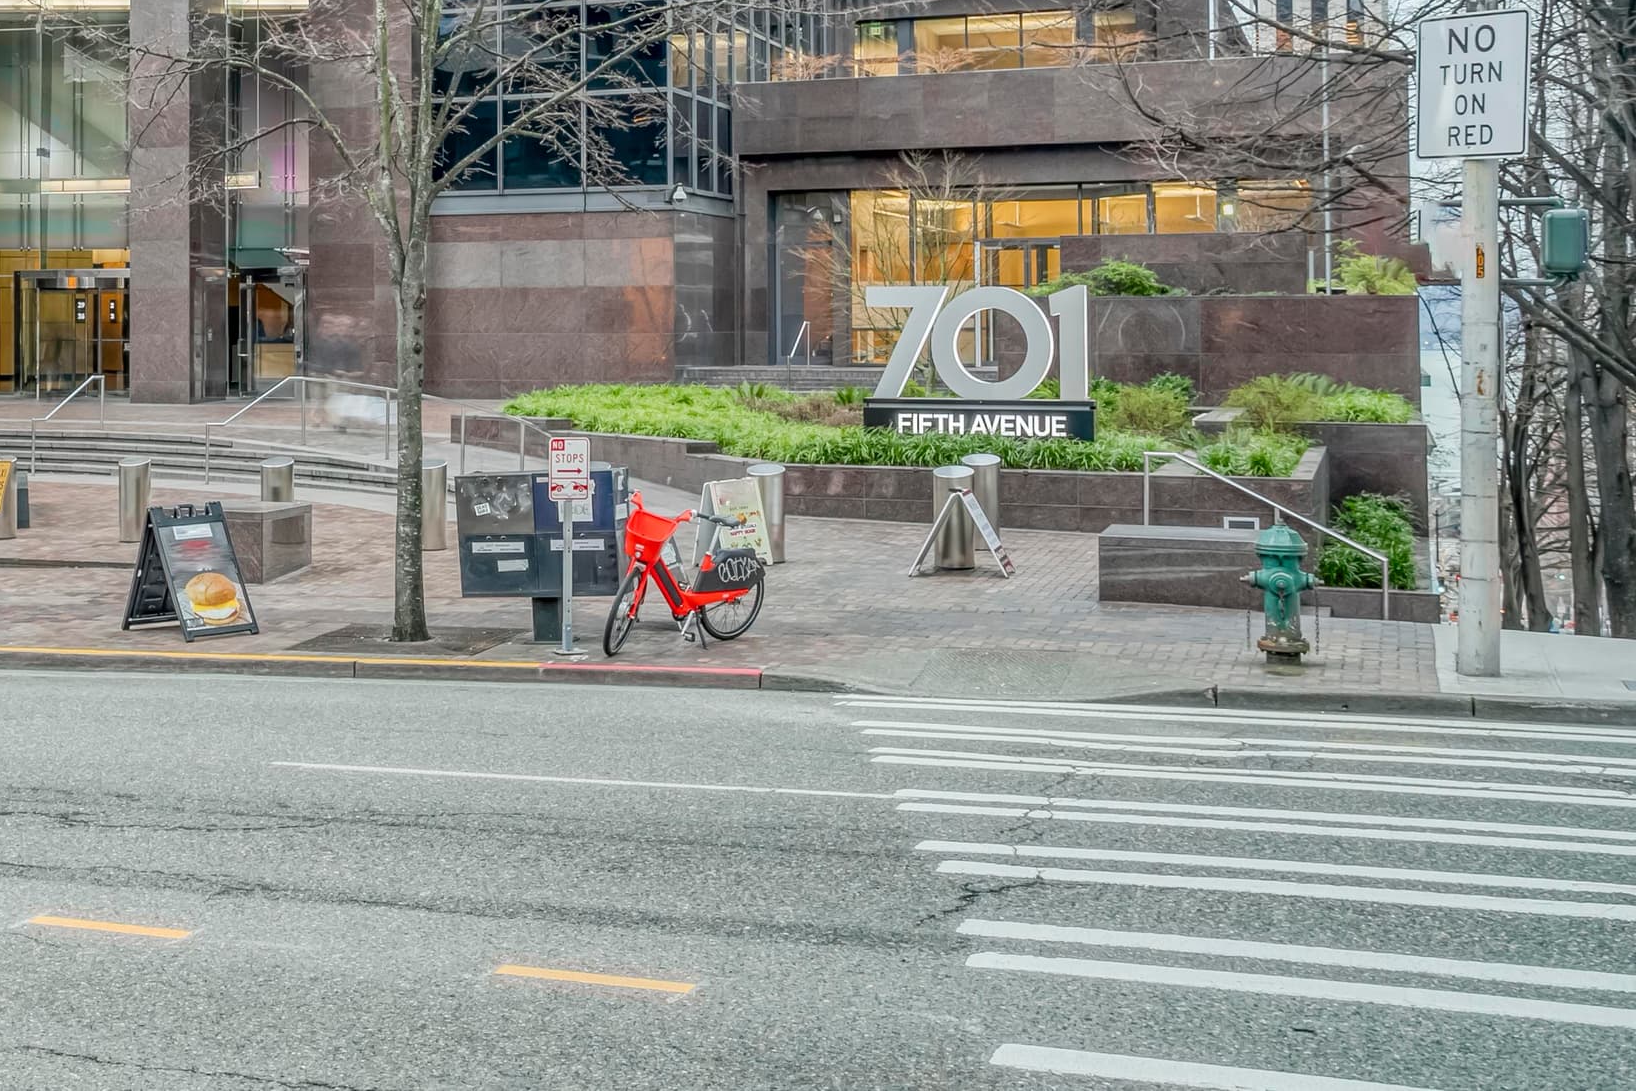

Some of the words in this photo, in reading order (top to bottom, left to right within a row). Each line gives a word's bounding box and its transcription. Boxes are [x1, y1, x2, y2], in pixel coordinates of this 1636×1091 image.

[1447, 24, 1496, 55] NO
[1440, 60, 1503, 86] TURN
[1454, 93, 1486, 116] ON
[1447, 124, 1493, 147] RED
[865, 285, 1089, 401] 701
[897, 412, 965, 435] FIFTH
[970, 413, 1068, 437] AVENUE
[552, 440, 564, 450] NO
[555, 453, 584, 464] STOPS
